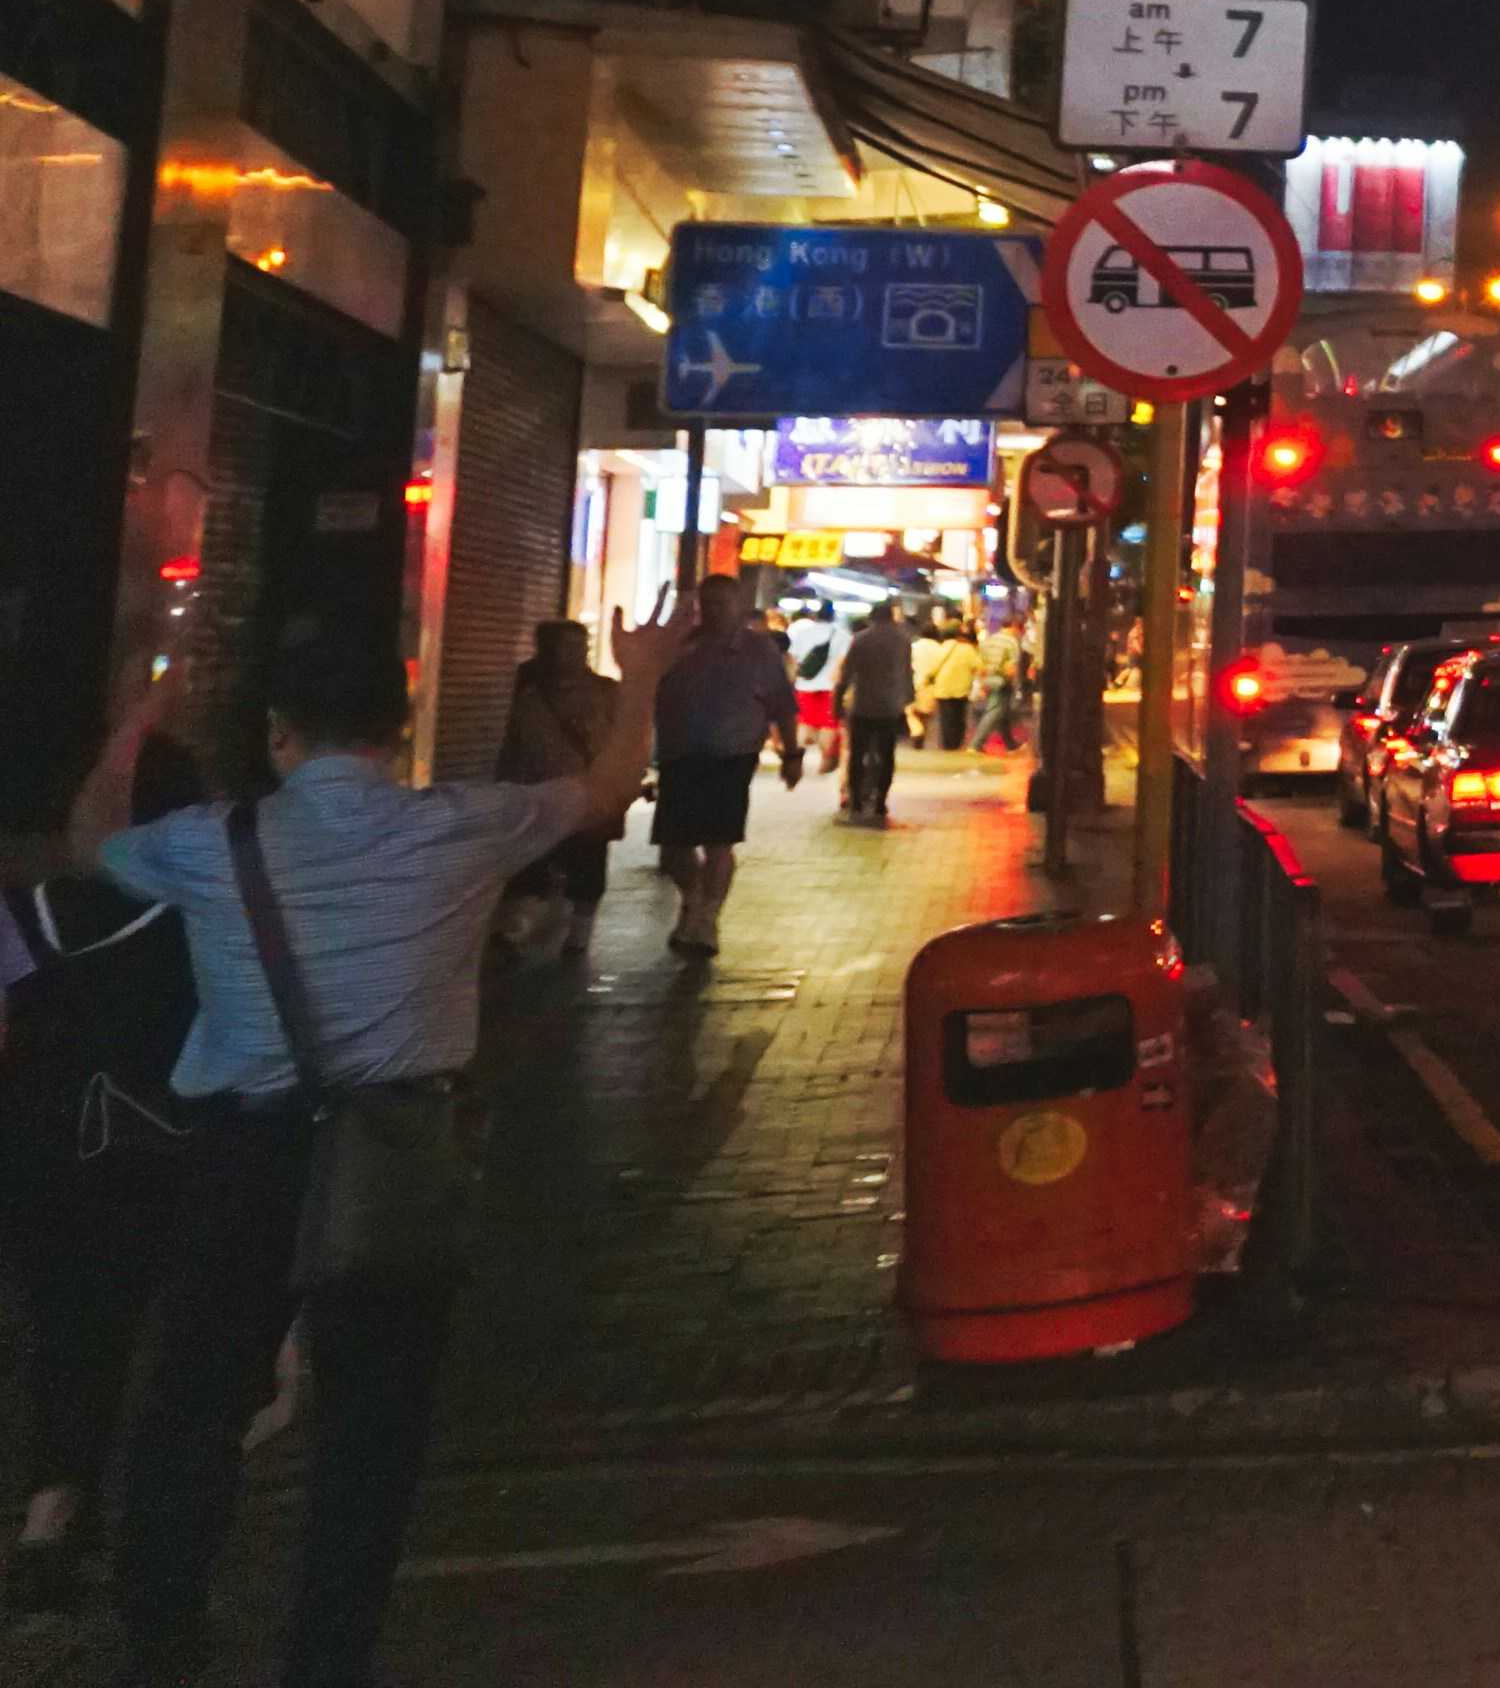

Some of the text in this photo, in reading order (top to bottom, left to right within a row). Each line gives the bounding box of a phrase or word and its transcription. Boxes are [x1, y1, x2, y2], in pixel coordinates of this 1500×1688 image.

[1111, 25, 1185, 56] 上午
[1128, 2, 1265, 59] am 7
[1107, 109, 1181, 138] 下午
[1123, 83, 1260, 140] pm 7
[693, 240, 952, 273] Hong Kong (W)
